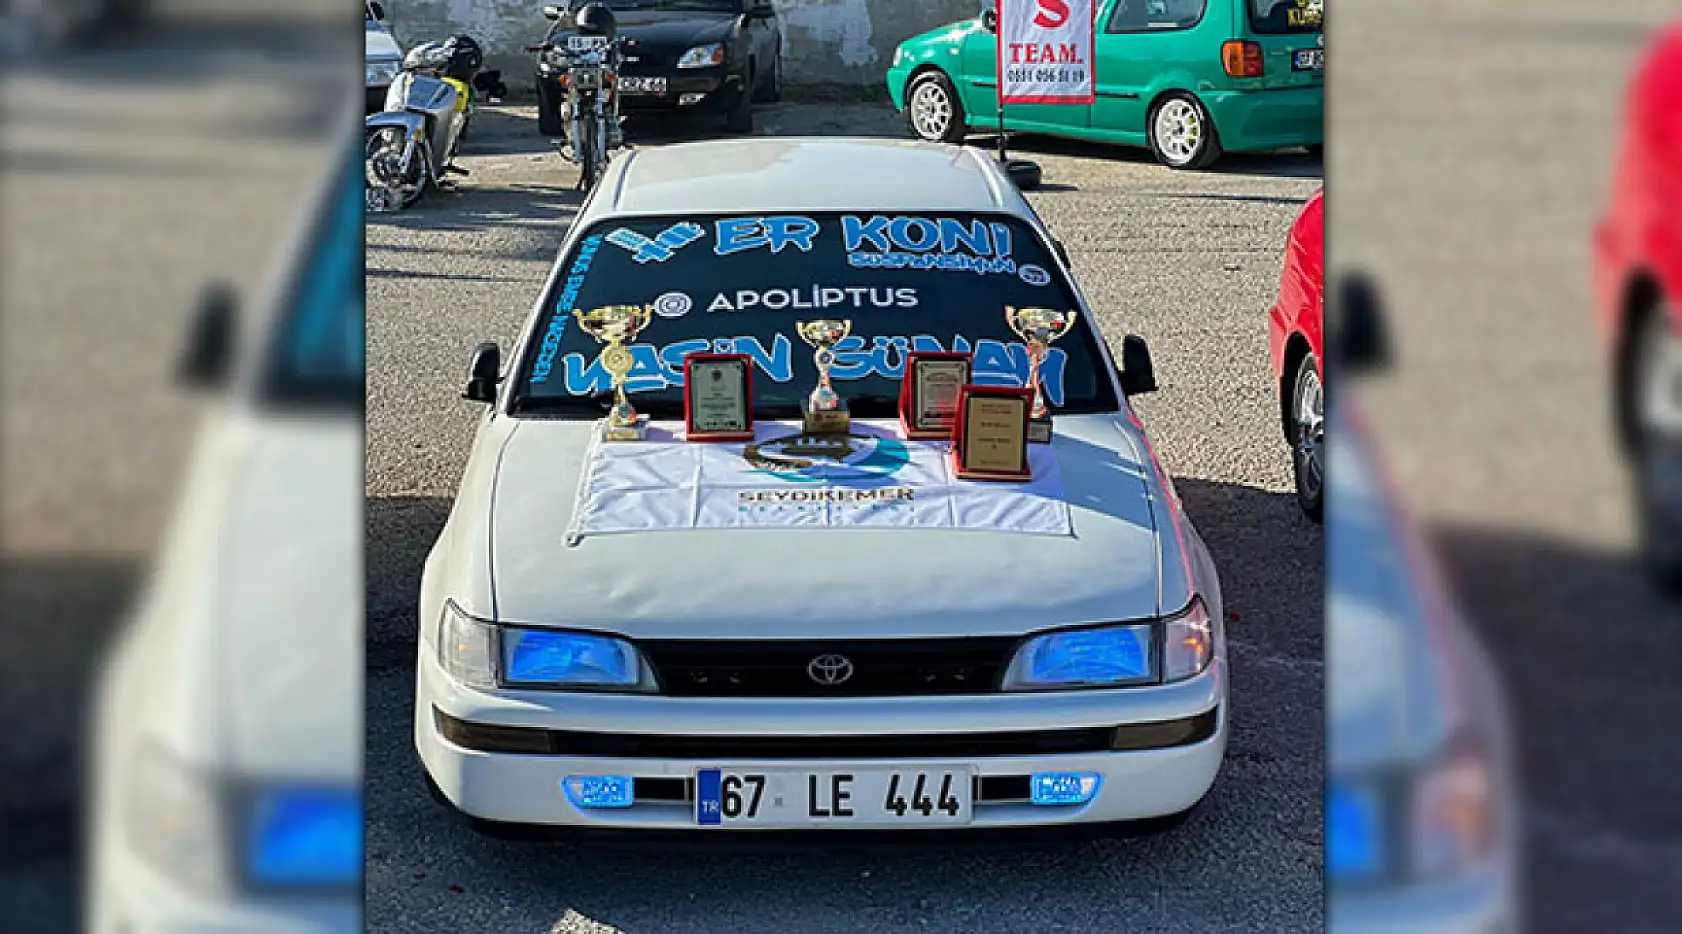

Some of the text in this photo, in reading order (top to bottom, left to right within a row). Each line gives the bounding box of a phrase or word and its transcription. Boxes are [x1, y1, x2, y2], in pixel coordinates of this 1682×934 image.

[1008, 42, 1085, 65] TEAM.
[713, 216, 819, 256] ER
[706, 283, 919, 313] APOLİPTUS
[721, 773, 767, 819] 67
[808, 773, 854, 818] LE
[885, 773, 960, 818] 444
